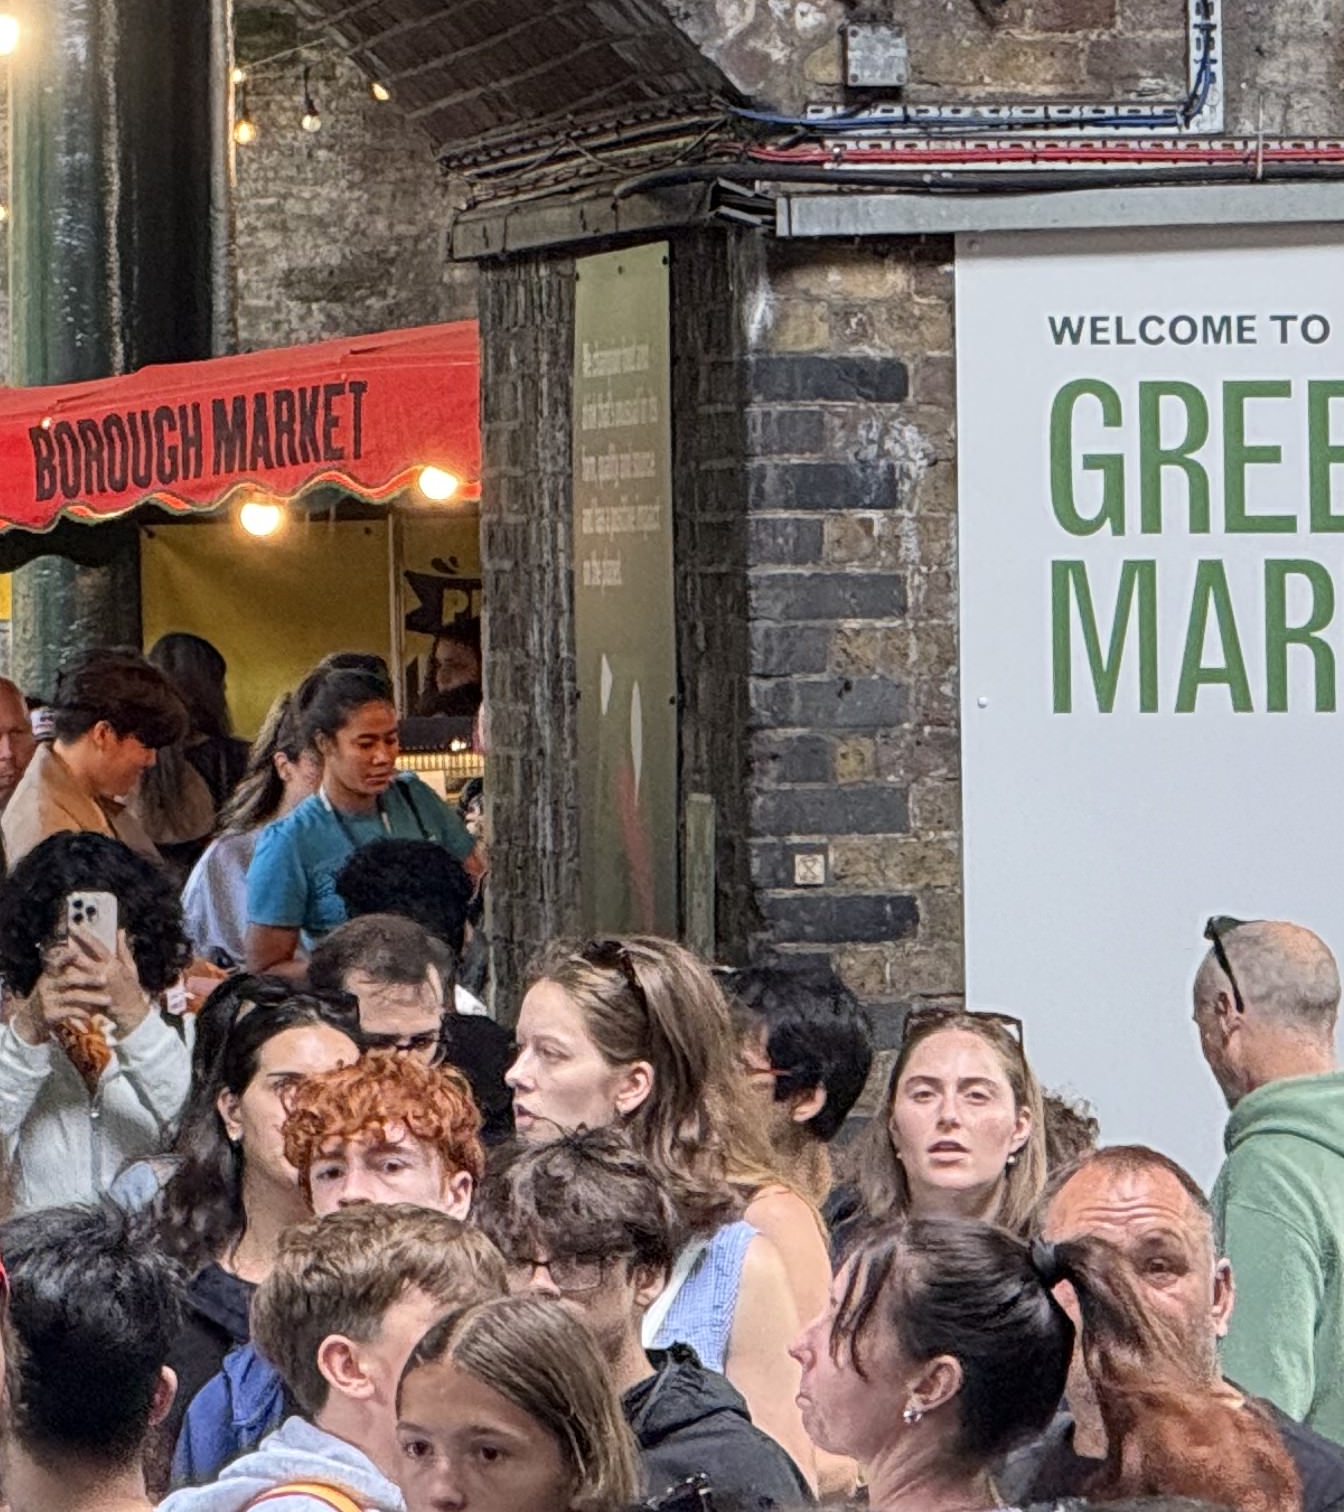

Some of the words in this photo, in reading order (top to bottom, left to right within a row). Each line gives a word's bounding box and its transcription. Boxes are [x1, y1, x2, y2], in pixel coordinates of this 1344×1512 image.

[1048, 314, 1257, 345] WELCOME
[1269, 314, 1331, 345] TO
[29, 402, 203, 502] BOROUGH
[211, 380, 368, 475] MARKET
[1051, 558, 1336, 714] MAR
